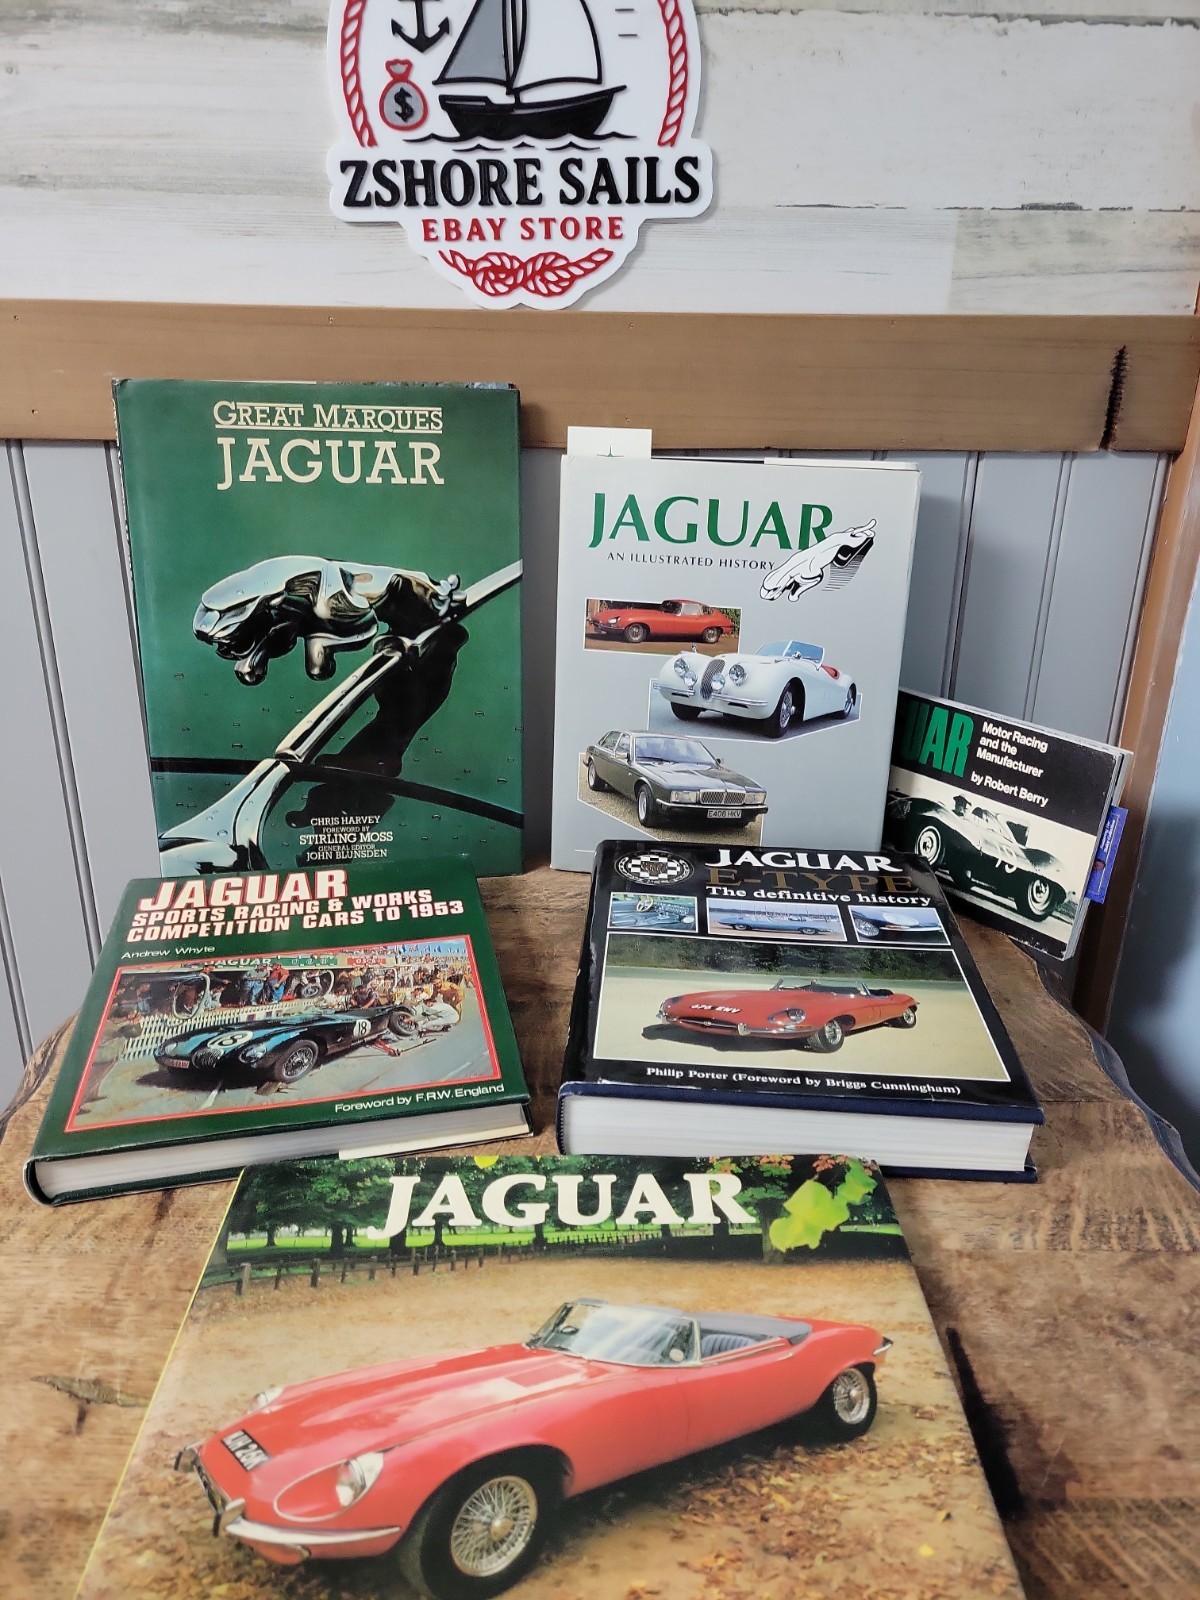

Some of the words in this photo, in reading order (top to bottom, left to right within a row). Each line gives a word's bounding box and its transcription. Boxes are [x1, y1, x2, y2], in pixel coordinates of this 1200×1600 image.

[340, 157, 543, 207] ZSHORE
[559, 156, 700, 205] SAILS
[422, 217, 506, 242] EBAY
[520, 216, 624, 241] STORE
[213, 400, 304, 427] GREAT
[313, 403, 443, 432] MARQUES
[216, 437, 445, 490] JAGUAR
[588, 492, 833, 550] JAGUAR
[607, 552, 625, 561] AN
[630, 553, 713, 567] ILLUSTRATED
[719, 558, 776, 570] HISTORY
[980, 736, 999, 749] and
[1001, 740, 1018, 755] the
[982, 721, 1012, 740] Motor
[1012, 730, 1049, 753] Racing
[976, 746, 1044, 778] Manufacturer
[970, 770, 984, 786] by
[983, 775, 1019, 796] Robert
[1018, 787, 1049, 807] Berry
[310, 817, 339, 826] CHRIS
[341, 815, 381, 825] HARVEY
[299, 833, 357, 845] STIRLING
[360, 831, 393, 843] MOSS
[306, 851, 333, 861] JOHN
[336, 849, 387, 860] BLUNSDEN
[705, 849, 903, 872] JAGUAR
[137, 869, 348, 911] JAGUAR
[705, 867, 920, 894] E-TYPE
[132, 907, 226, 927] SPORTS
[234, 900, 319, 920] RACING
[328, 899, 343, 912] &
[351, 889, 433, 910] WORKS
[705, 886, 746, 897] The
[753, 889, 851, 902] definitive
[858, 892, 931, 906] history
[126, 916, 290, 943] COMPETITION
[303, 910, 364, 929] CARS
[372, 906, 401, 922] TO
[408, 899, 464, 918] 1953
[121, 949, 171, 960] Andrew
[175, 945, 215, 955] Whyte
[358, 1021, 367, 1036] 18
[646, 1067, 684, 1078] Philip
[688, 1069, 728, 1081] Porter
[732, 1072, 801, 1085] (Foreword
[805, 1075, 821, 1086] by
[826, 1078, 867, 1090] Briggs
[870, 1080, 961, 1096] Cunningham)
[334, 1096, 395, 1112] Foreword
[397, 1095, 412, 1105] by
[416, 1090, 453, 1103] F.R.W.
[455, 1083, 505, 1098] England
[366, 1172, 757, 1240] JAGUAR
